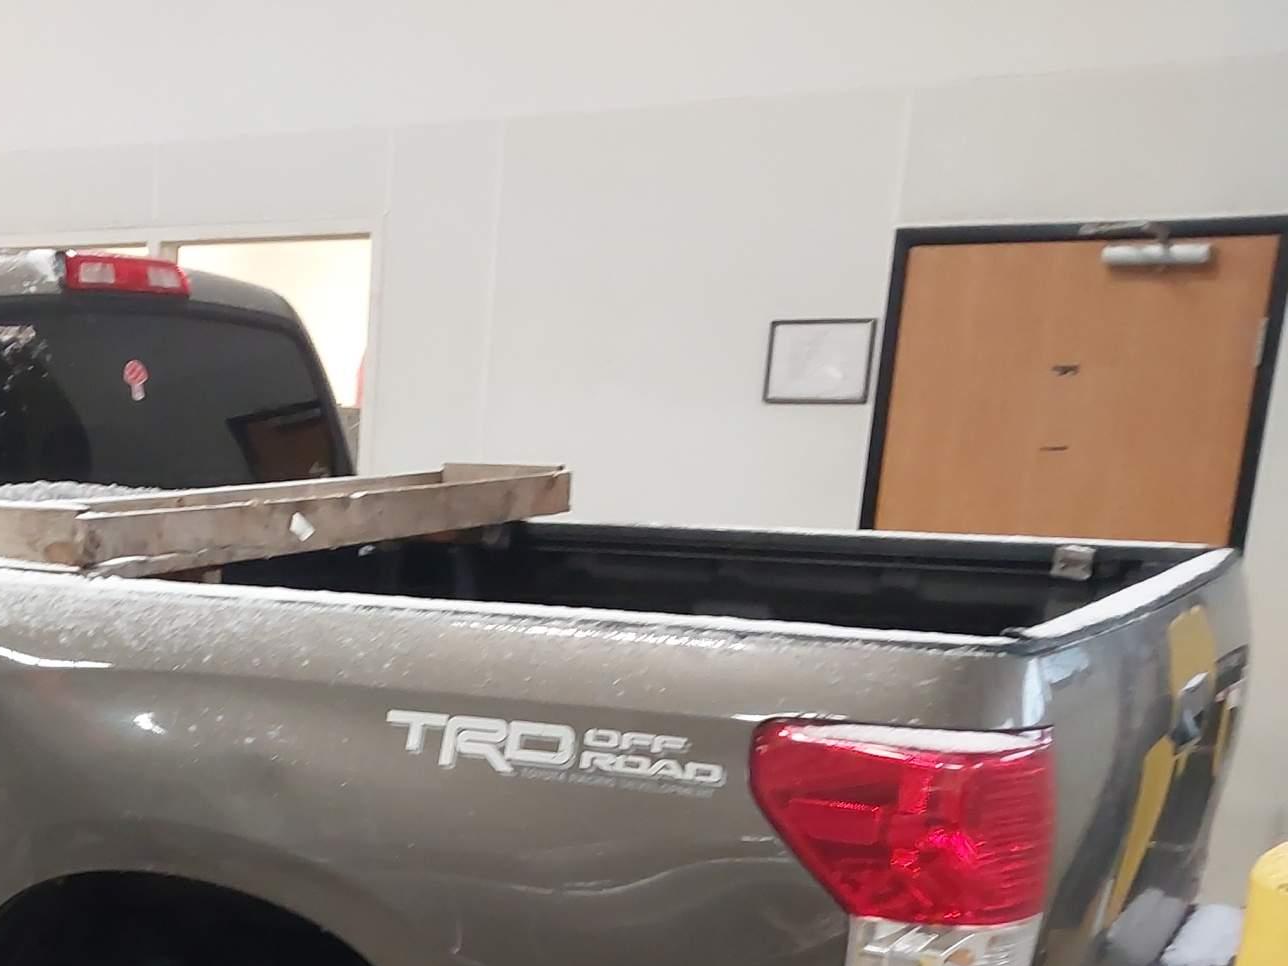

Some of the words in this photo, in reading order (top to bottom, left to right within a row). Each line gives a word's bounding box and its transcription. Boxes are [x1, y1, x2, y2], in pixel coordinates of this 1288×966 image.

[386, 709, 578, 776] TRD
[583, 727, 692, 755] OFF
[578, 750, 726, 786] ROAD
